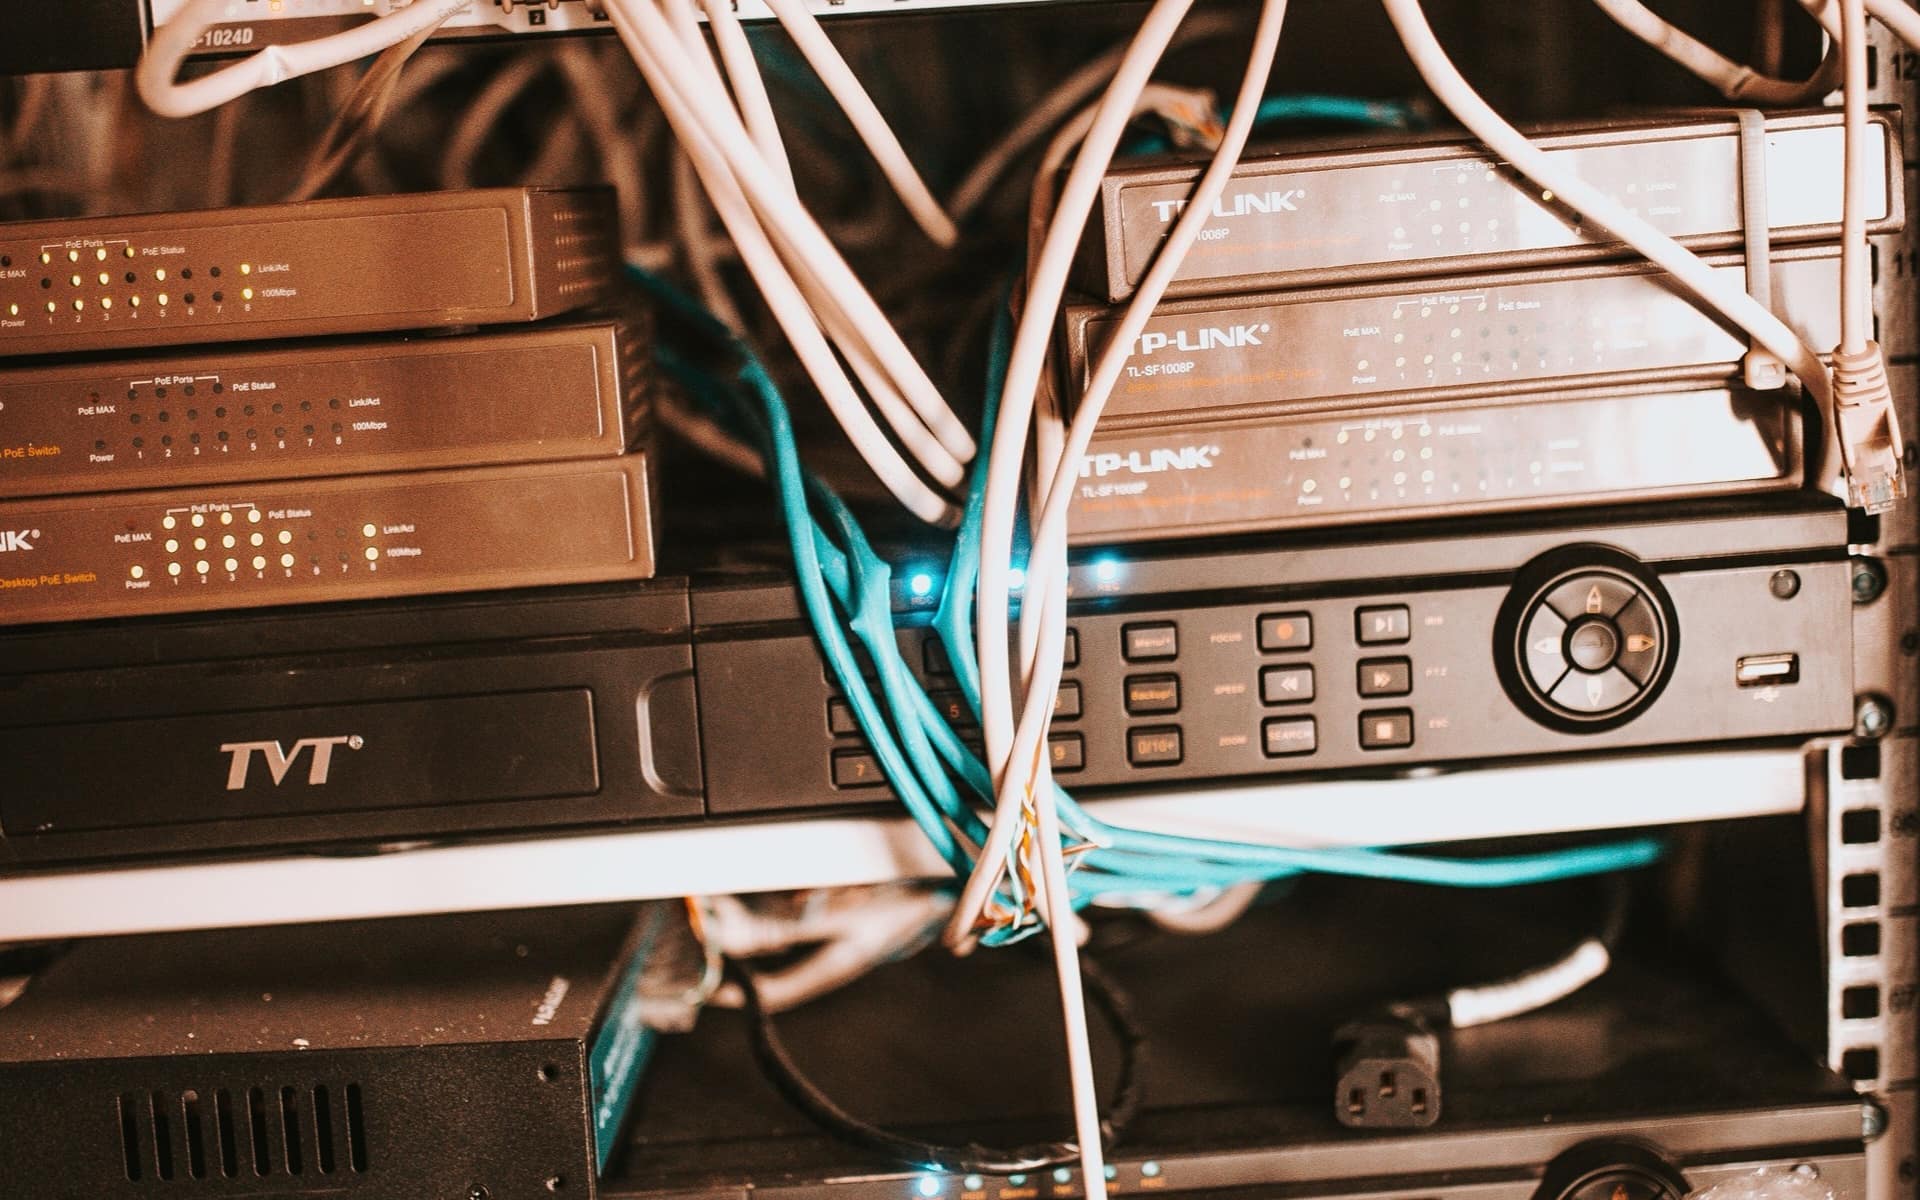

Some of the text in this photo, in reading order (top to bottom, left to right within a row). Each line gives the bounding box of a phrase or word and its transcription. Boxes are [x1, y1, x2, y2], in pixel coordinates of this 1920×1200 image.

[1397, 192, 1416, 201] MAX
[83, 239, 104, 247] Ports
[143, 246, 185, 256] PoE Status
[258, 263, 290, 273] Link/Act
[8, 270, 26, 278] MAX
[262, 288, 297, 298] 100Mbps
[1, 319, 26, 328] Power
[1344, 327, 1380, 337] PoE MAX
[155, 375, 194, 384] PoE Ports
[233, 381, 276, 392] PoE Status
[349, 397, 380, 407] Link/Act
[78, 406, 116, 415] PoE MAX
[352, 421, 387, 431] 100Mbps
[4, 445, 61, 458] PoE Switch
[90, 453, 114, 463] Power
[192, 503, 230, 513] PoE Ports
[269, 508, 311, 520] PoE Status
[114, 532, 152, 543] PoE MAX
[40, 573, 61, 585] PoE
[64, 571, 96, 584] Switch
[126, 579, 150, 590] Power
[950, 706, 960, 718] 5
[220, 736, 348, 790] TVT
